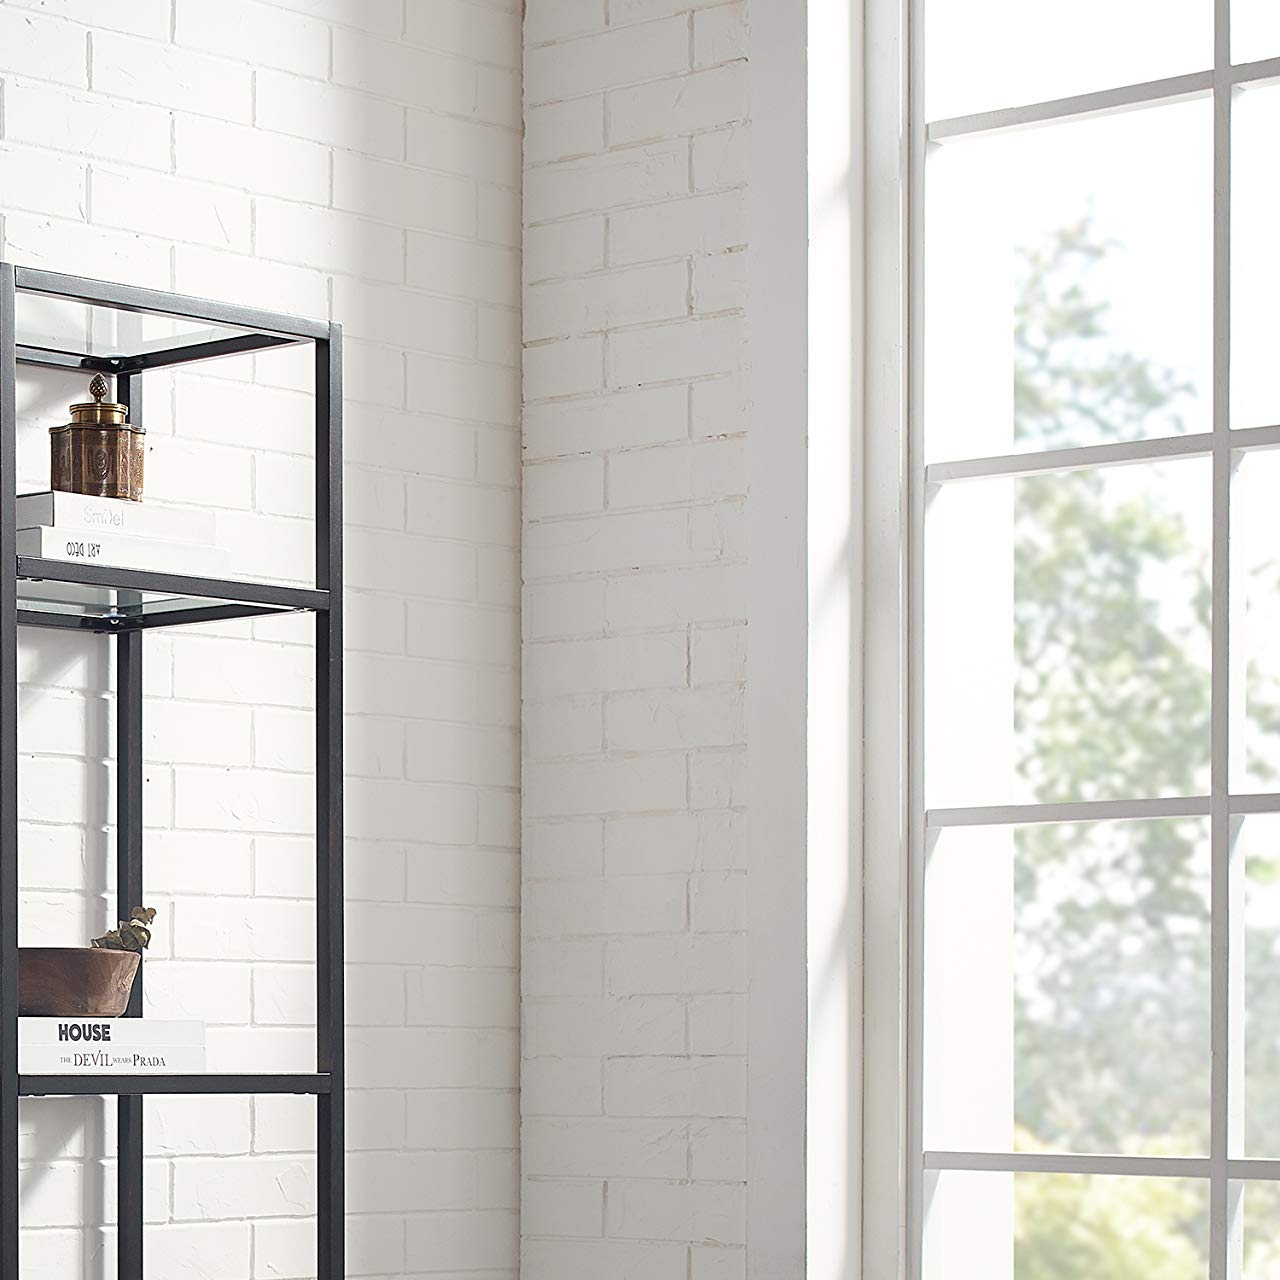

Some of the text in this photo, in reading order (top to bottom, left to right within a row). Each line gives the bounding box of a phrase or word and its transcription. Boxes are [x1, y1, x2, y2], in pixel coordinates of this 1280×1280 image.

[58, 1023, 111, 1042] HOUSE
[73, 1050, 113, 1067] DEVIL
[133, 1054, 166, 1067] PRADA
